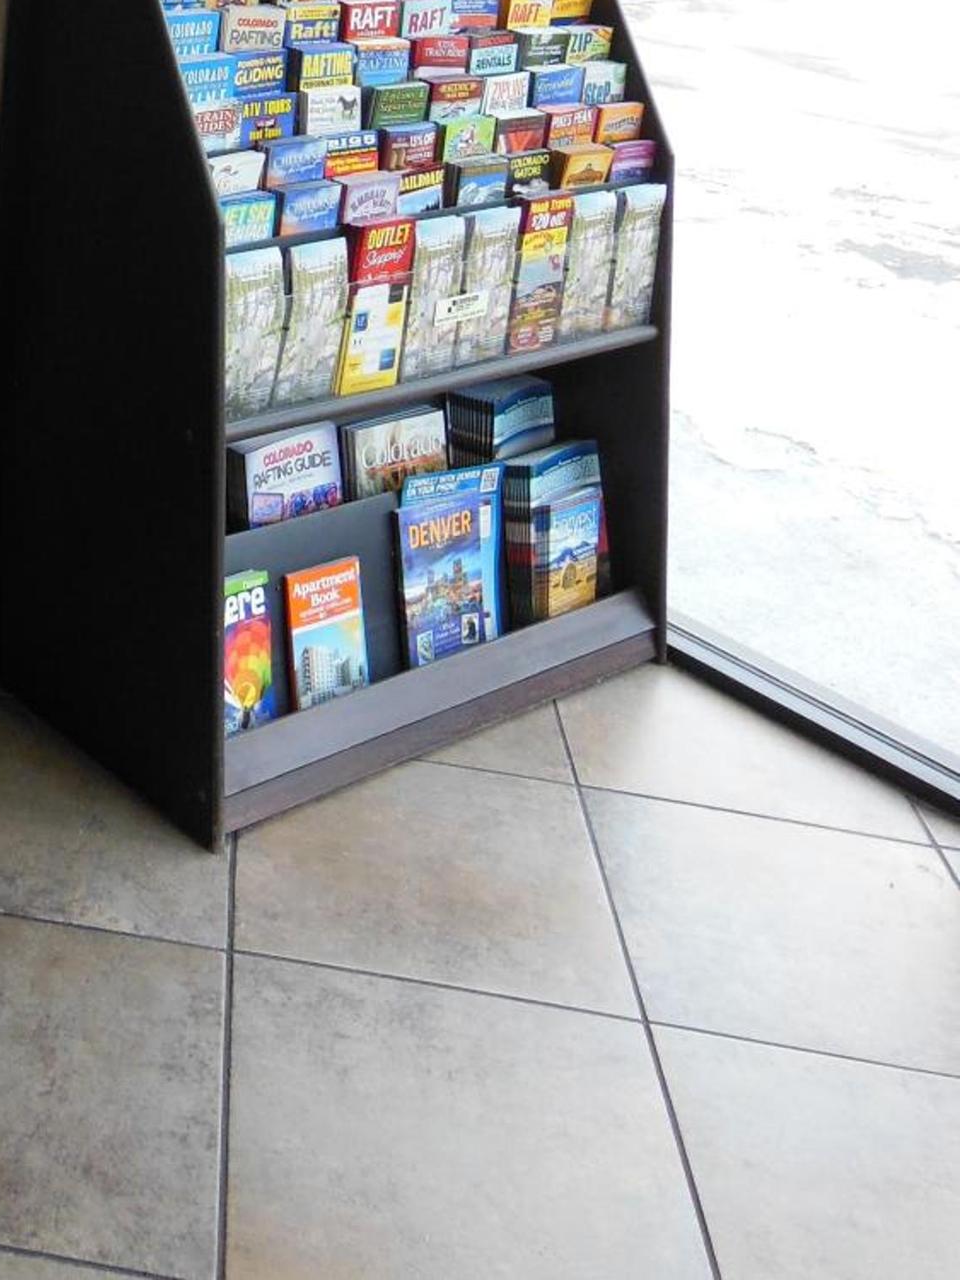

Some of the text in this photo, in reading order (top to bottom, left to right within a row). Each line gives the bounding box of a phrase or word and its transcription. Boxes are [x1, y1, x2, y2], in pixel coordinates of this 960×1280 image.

[237, 17, 279, 28] COLORADO
[350, 6, 396, 32] RAFT
[408, 7, 447, 34] RAFT
[510, 3, 542, 23] RAFT
[229, 30, 281, 47] RAFTING
[291, 21, 336, 40] Raft!
[570, 32, 593, 54] ZIP
[234, 65, 284, 86] GLIDING
[196, 110, 233, 123] TRAIN
[510, 154, 550, 170] COLORADO
[514, 165, 542, 179] GATORS
[368, 223, 411, 250] OUTLET
[263, 440, 313, 467] COLORADO
[361, 433, 443, 469] Colorado
[253, 450, 333, 489] RAFTING GUIDE
[408, 510, 473, 549] DENVER
[293, 568, 356, 598] Apartment
[224, 587, 266, 626] ere
[310, 590, 341, 608] Book
